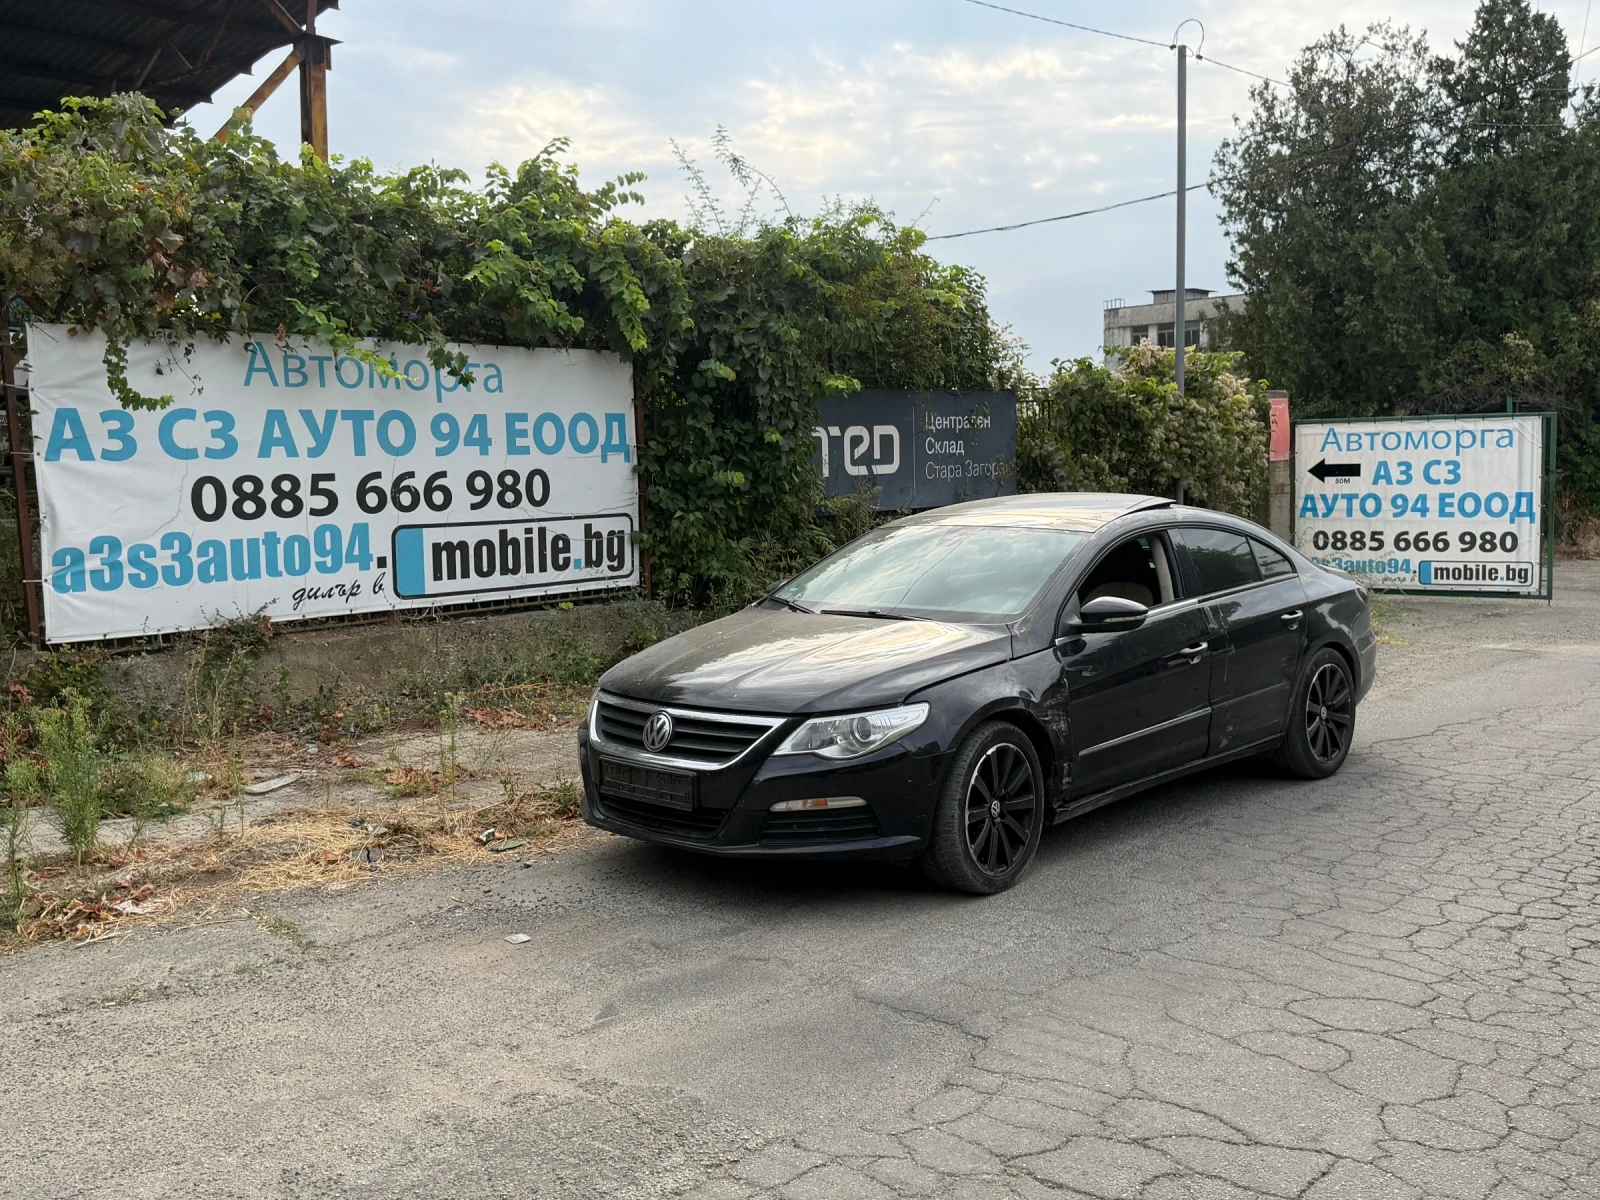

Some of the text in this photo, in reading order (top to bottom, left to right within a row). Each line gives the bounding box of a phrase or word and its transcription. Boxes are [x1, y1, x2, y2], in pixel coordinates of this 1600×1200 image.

[257, 409, 416, 458] АУТО
[430, 412, 493, 457] 94
[505, 412, 631, 463] ЕООД
[925, 437, 965, 456] Склад
[1320, 427, 1514, 456] Автоморга
[925, 461, 962, 482] Стара
[190, 468, 551, 522] 0885 666 980
[1299, 492, 1536, 524] АУТО 94 ЕООД
[432, 523, 626, 582] mobile.bg
[1313, 530, 1519, 553] 0885 666 980
[1433, 564, 1529, 583] mobile.bg
[292, 579, 362, 611] дилър
